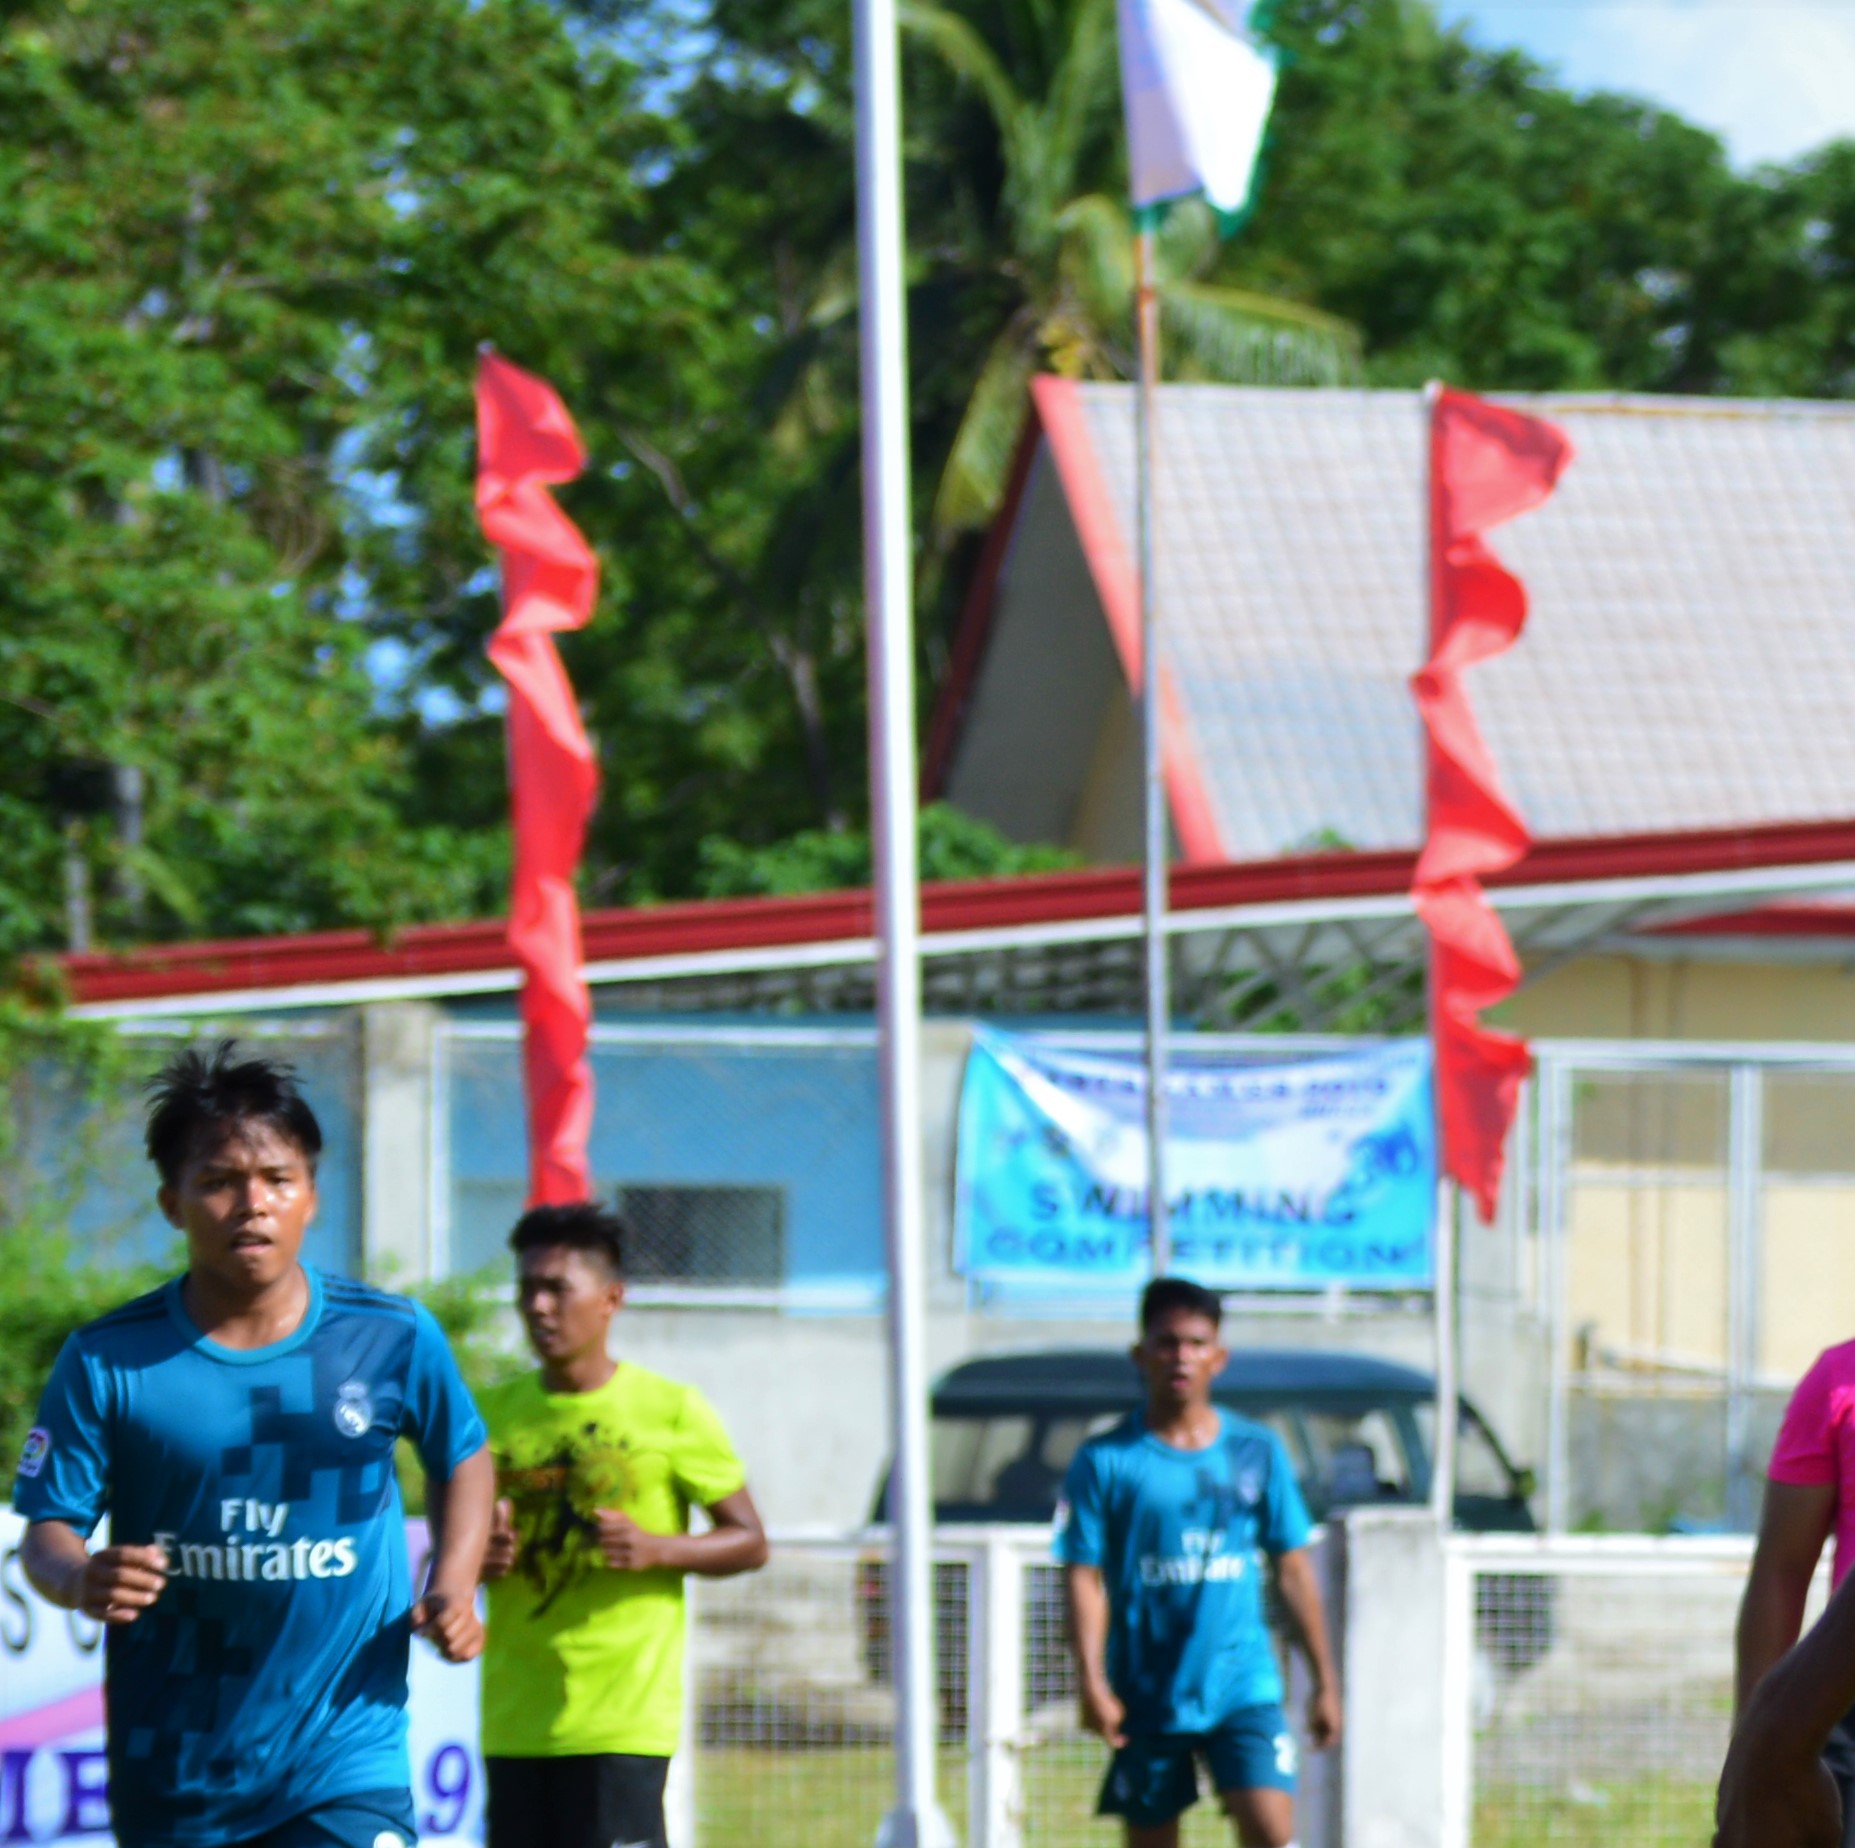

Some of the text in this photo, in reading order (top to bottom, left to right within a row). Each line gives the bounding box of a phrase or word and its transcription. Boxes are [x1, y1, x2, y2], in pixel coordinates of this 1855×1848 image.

[987, 1228, 1412, 1272] COMETITION
[220, 1498, 289, 1539] Fly
[153, 1530, 360, 1581] Emirates
